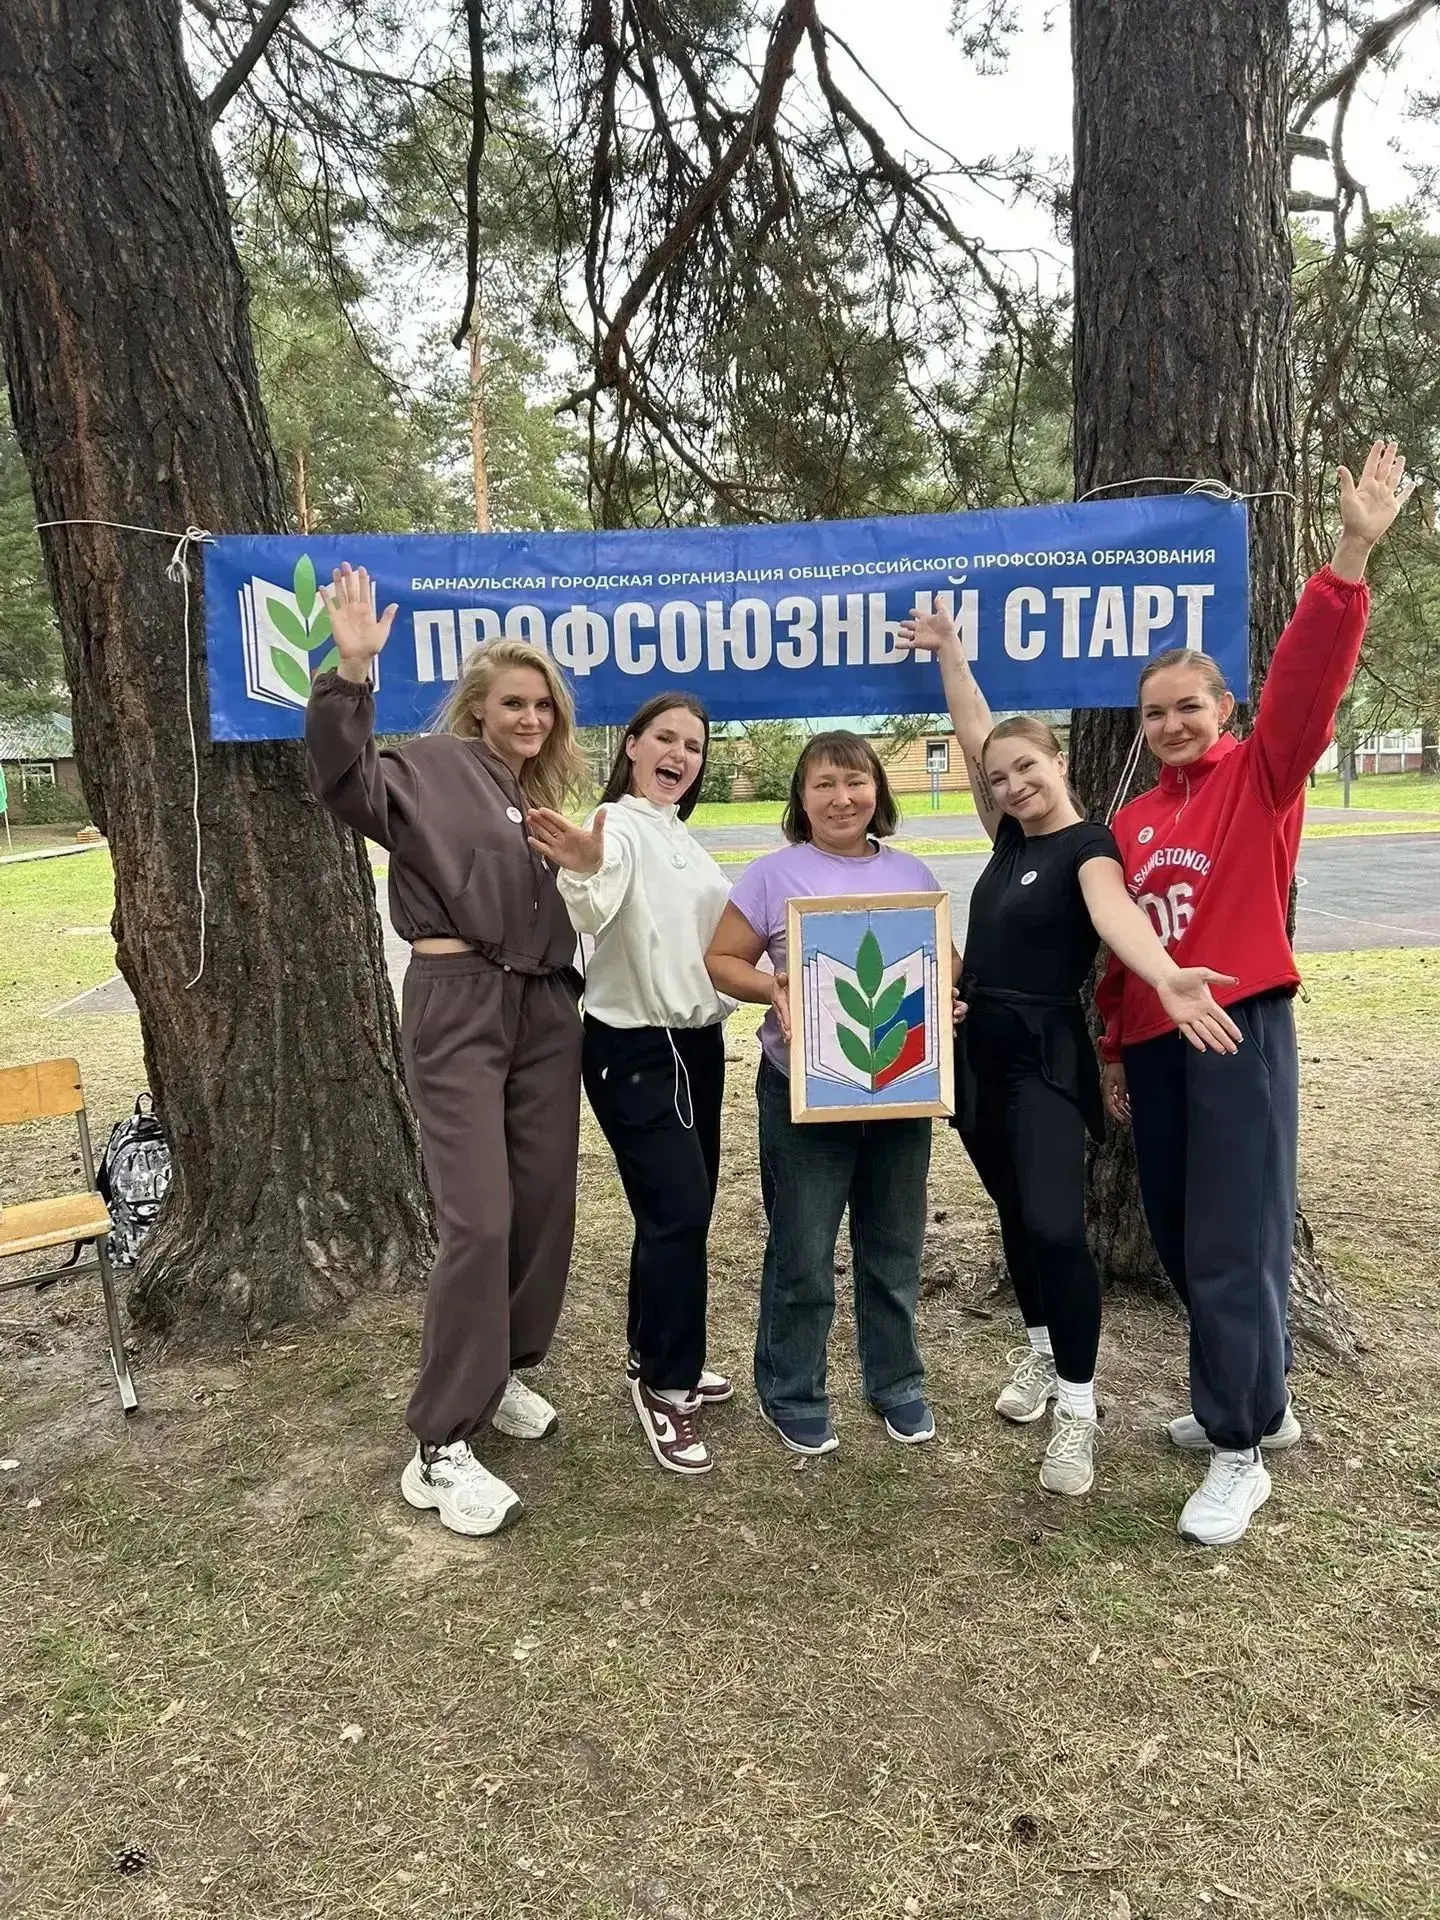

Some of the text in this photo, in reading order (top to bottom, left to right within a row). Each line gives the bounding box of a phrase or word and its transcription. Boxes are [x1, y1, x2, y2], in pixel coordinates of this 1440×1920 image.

[411, 549, 1216, 591] БАРНАУЛЬСКАЯ ГОРОДСКАЯ ОРГАНИЗАЦИЯ ОБЩЕРОССИЙСКОГО ПРОФСОЮЗА ОБРАЗОВАНИЯ
[1003, 584, 1215, 661] СТАРТ
